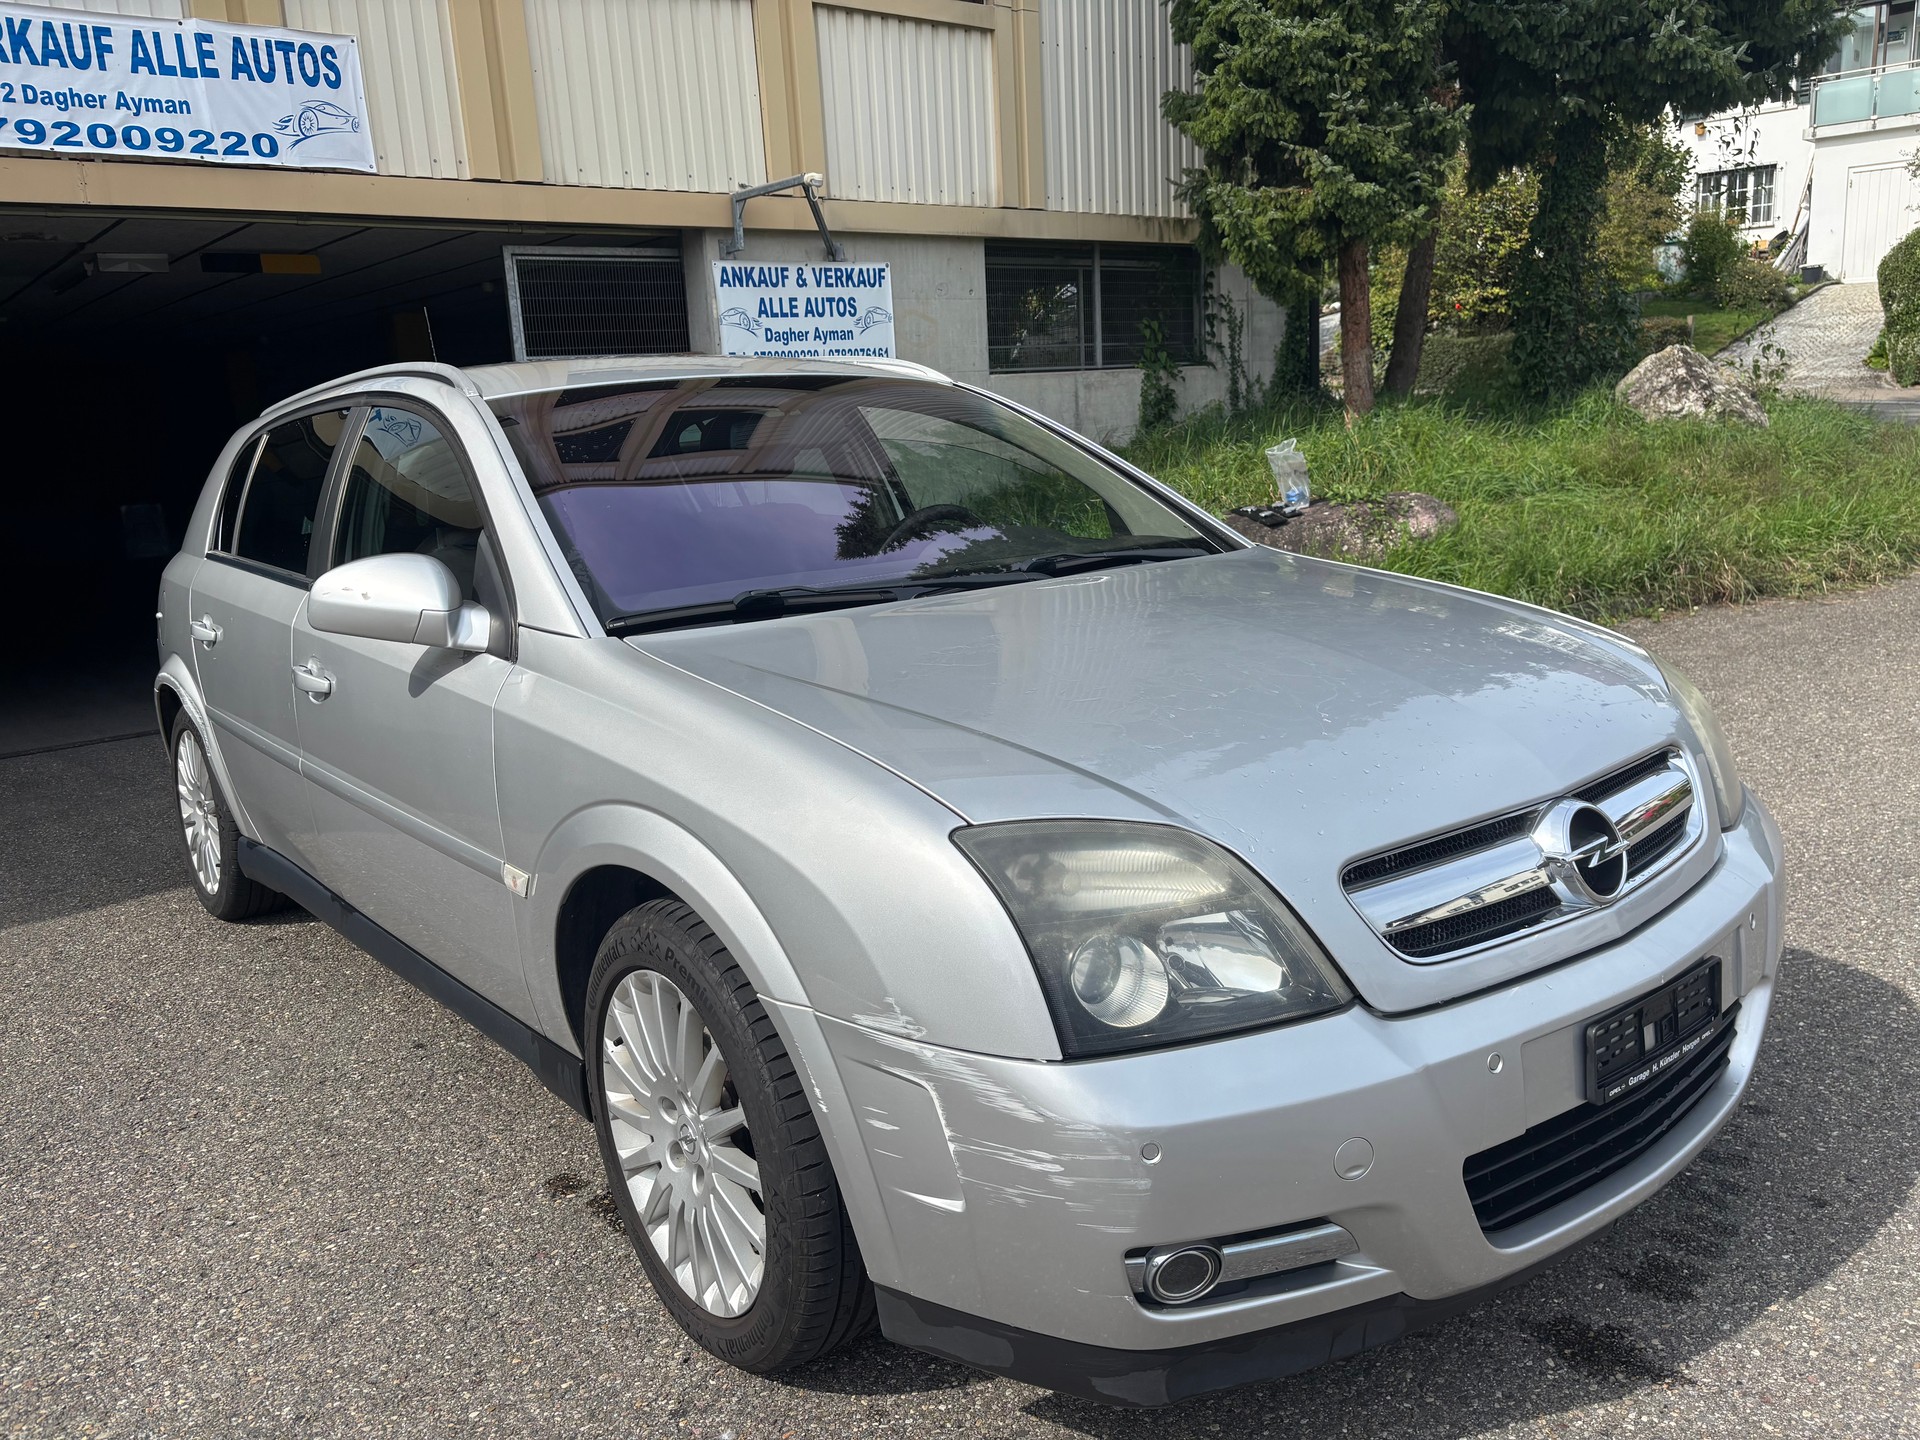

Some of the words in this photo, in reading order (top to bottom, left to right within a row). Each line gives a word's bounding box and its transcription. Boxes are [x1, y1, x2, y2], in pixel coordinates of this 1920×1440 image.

[130, 29, 220, 79] ALLE
[231, 36, 342, 90] AUTOS
[21, 84, 107, 112] Dagher
[115, 91, 191, 117] Ayman
[719, 266, 789, 288] ANKAUF
[796, 267, 808, 288] &
[812, 267, 886, 288] VERKAUF
[758, 297, 799, 318] ALLE
[804, 297, 858, 318] AUTOS
[765, 327, 809, 345] Dagher
[813, 327, 854, 345] Ayman
